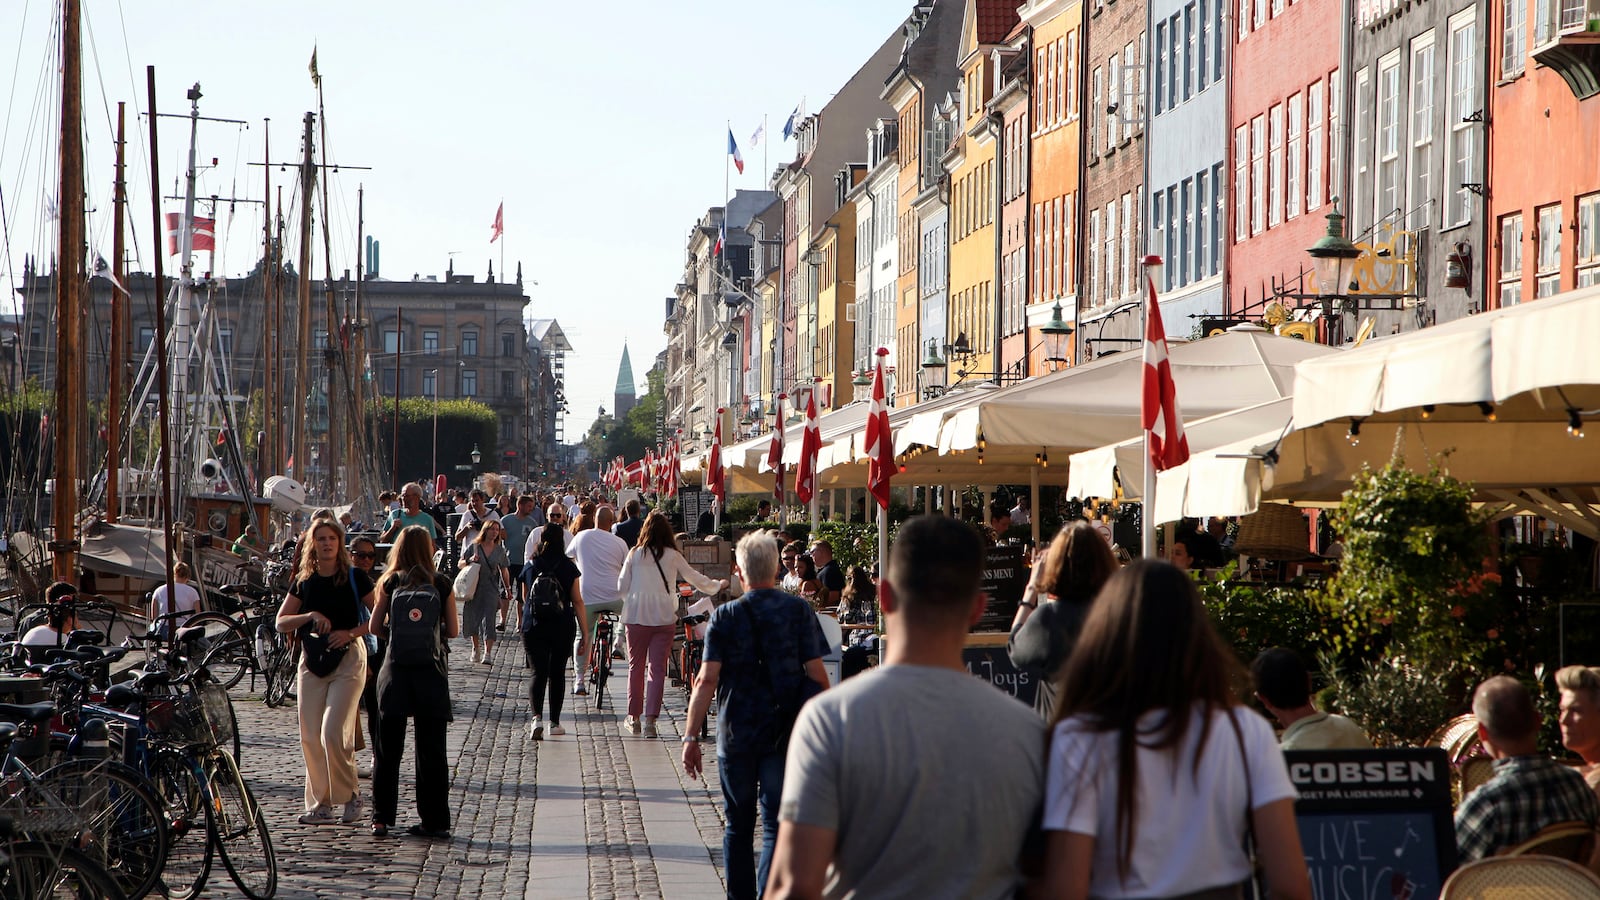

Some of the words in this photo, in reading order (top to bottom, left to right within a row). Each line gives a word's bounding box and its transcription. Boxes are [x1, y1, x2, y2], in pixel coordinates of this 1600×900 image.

[791, 387, 813, 410] 17
[202, 560, 248, 586] EMMA
[993, 568, 1014, 579] MENU
[1304, 819, 1376, 860] IVE
